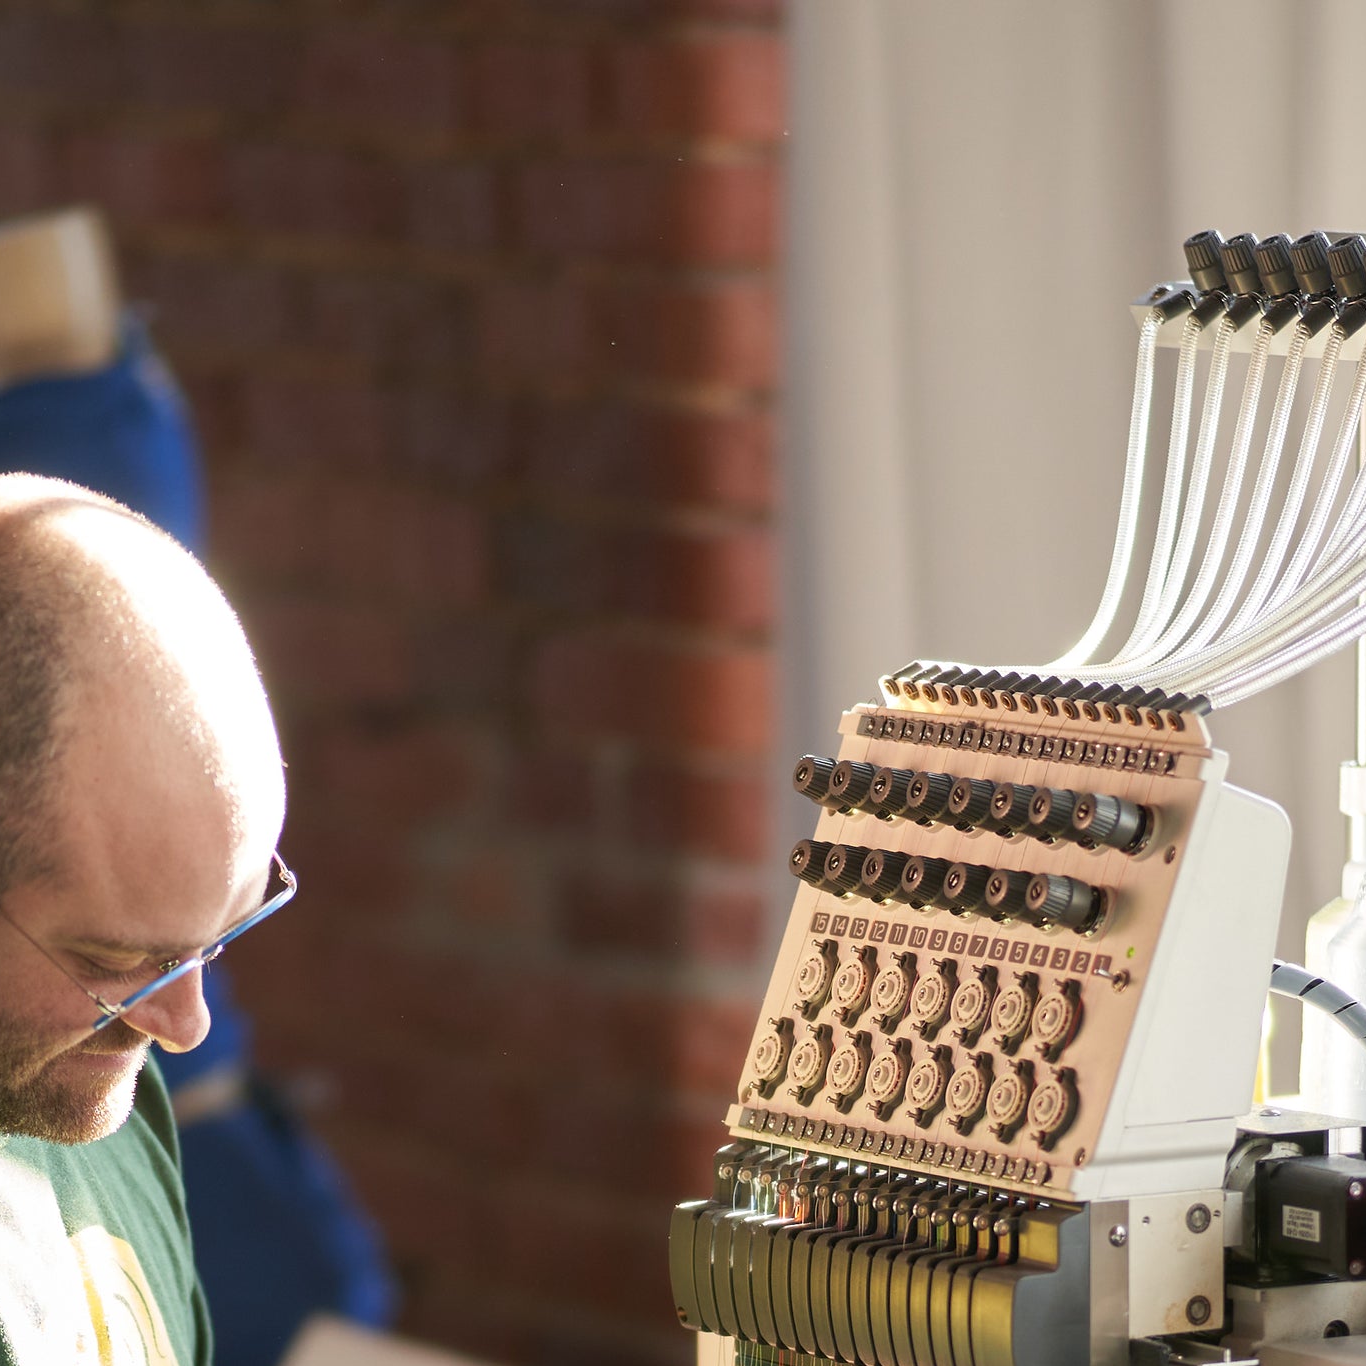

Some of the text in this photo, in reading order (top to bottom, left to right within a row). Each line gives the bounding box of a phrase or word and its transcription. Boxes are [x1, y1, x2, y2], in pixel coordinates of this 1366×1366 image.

[815, 914, 828, 931] 15
[833, 917, 846, 933] 14
[853, 920, 866, 936] 13
[873, 923, 885, 940] 12
[893, 926, 904, 942] 11
[913, 929, 926, 945] 10
